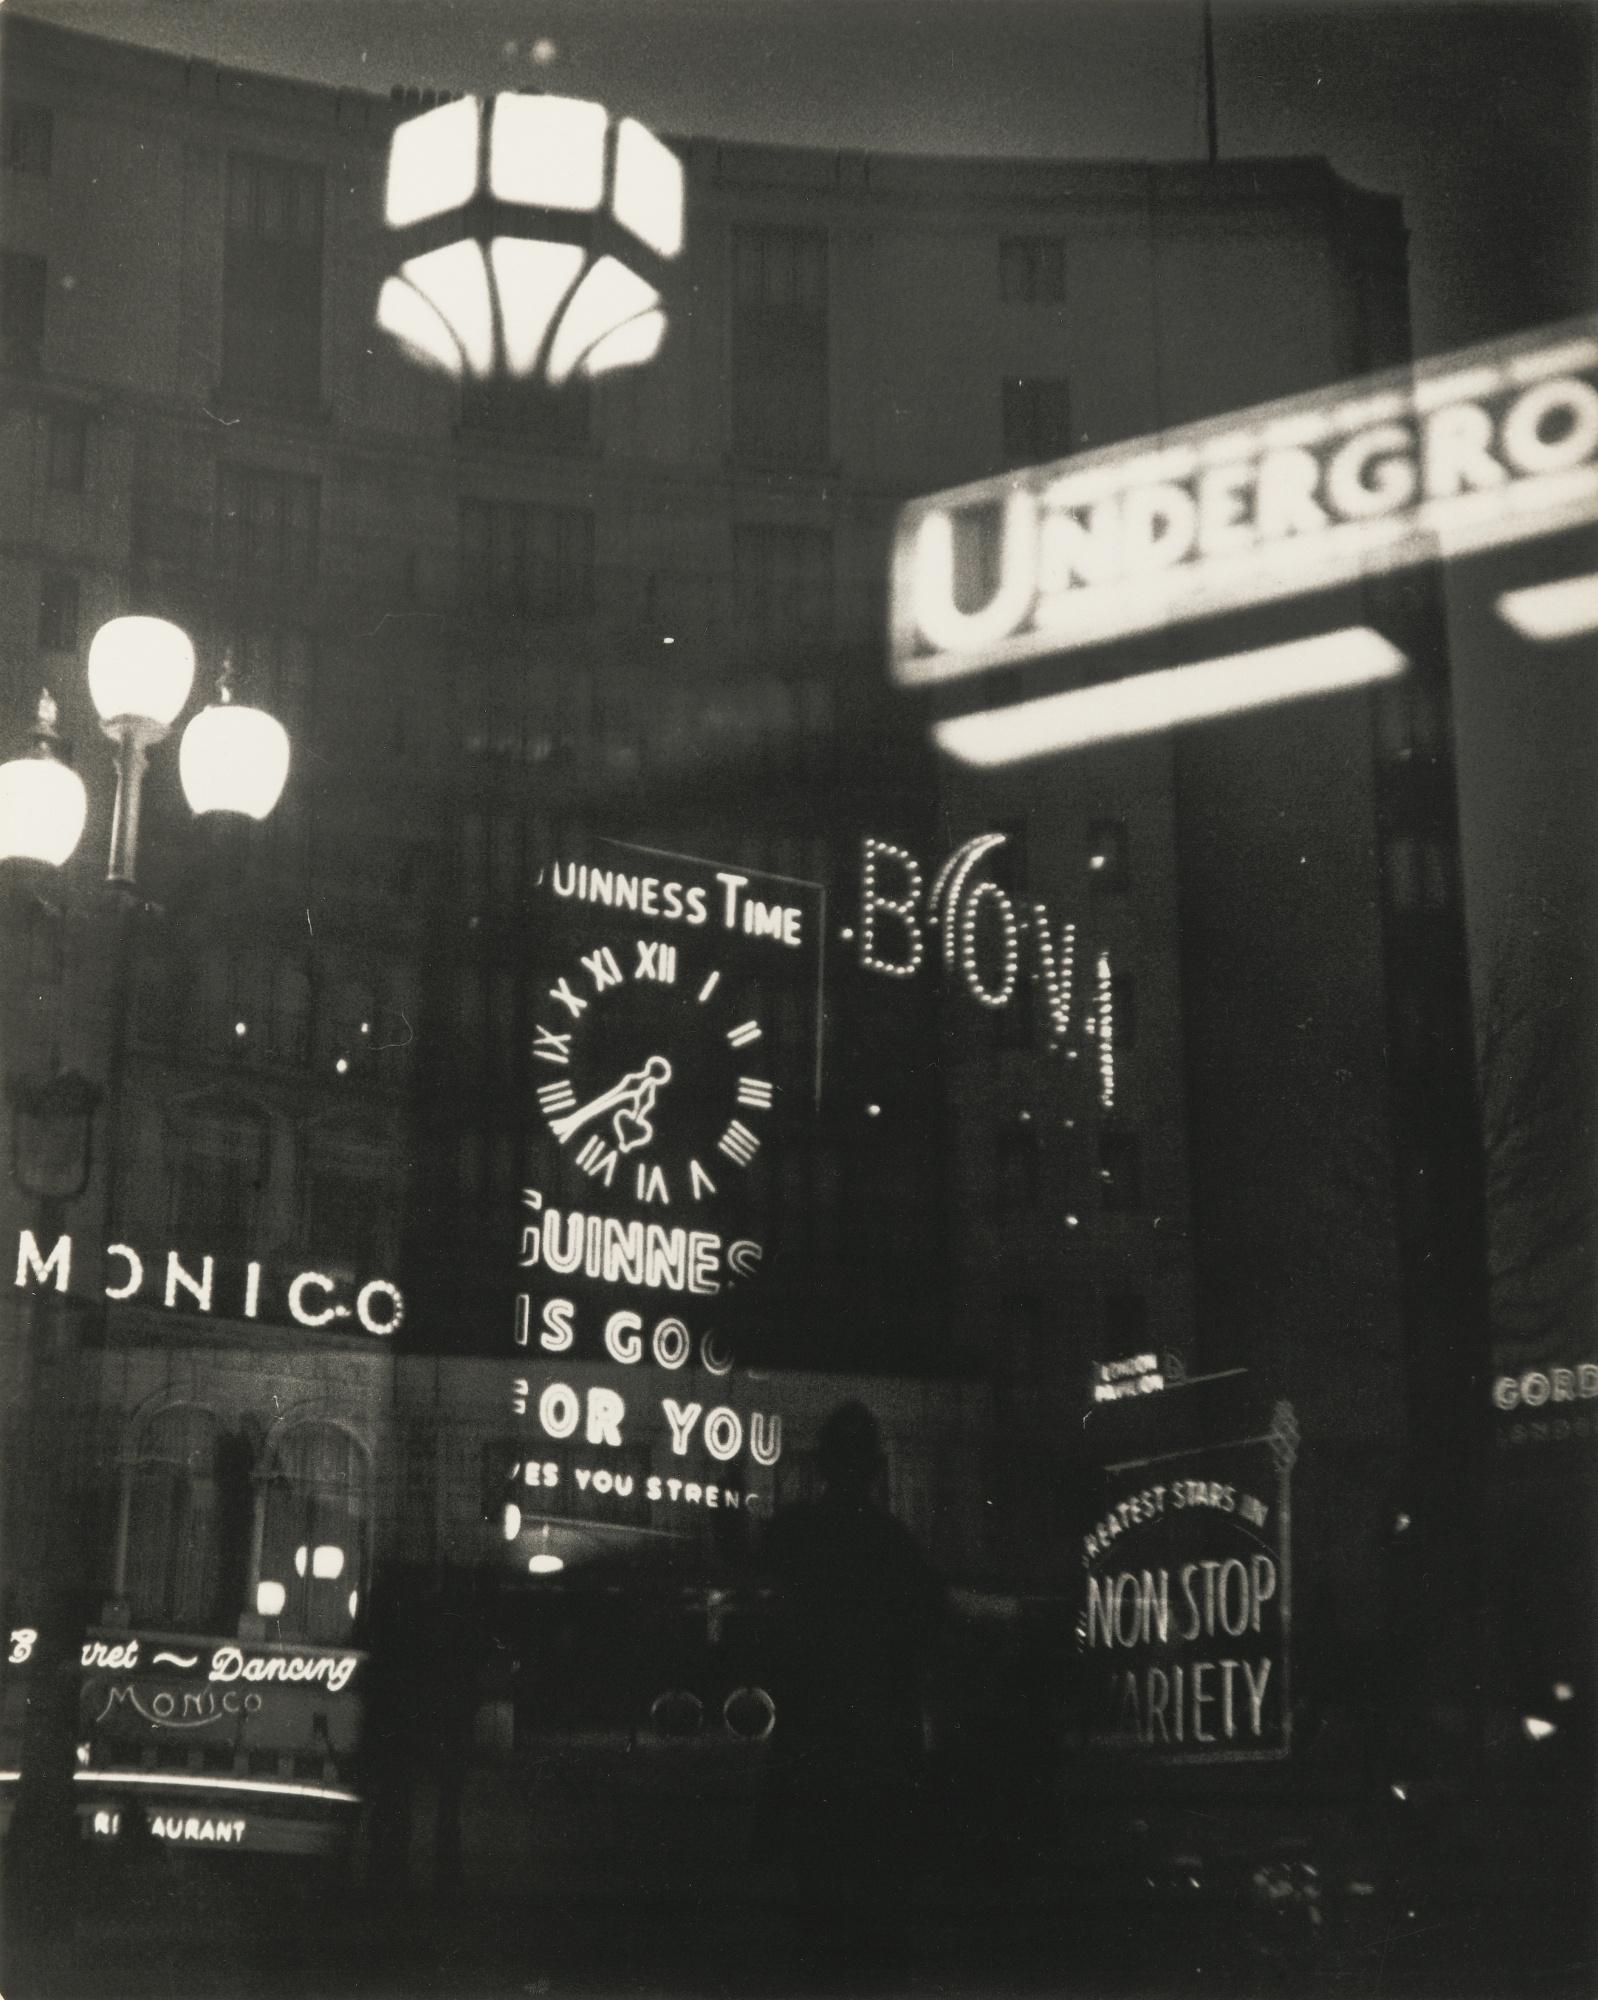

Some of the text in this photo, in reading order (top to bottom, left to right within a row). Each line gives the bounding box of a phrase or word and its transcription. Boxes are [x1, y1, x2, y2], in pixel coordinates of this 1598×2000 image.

[537, 861, 802, 945] UINNESS TIME
[634, 940, 676, 984] XII
[15, 1229, 403, 1335] MONICO
[515, 1294, 574, 1352] IS
[662, 1398, 782, 1466] YOU
[510, 1461, 559, 1487] ES
[575, 1468, 633, 1496] YOU
[1083, 1485, 1168, 1570] REATEST
[1087, 1554, 1277, 1650] NON STOP
[209, 1646, 357, 1692] Dancing
[1118, 1656, 1272, 1745] ARIETY
